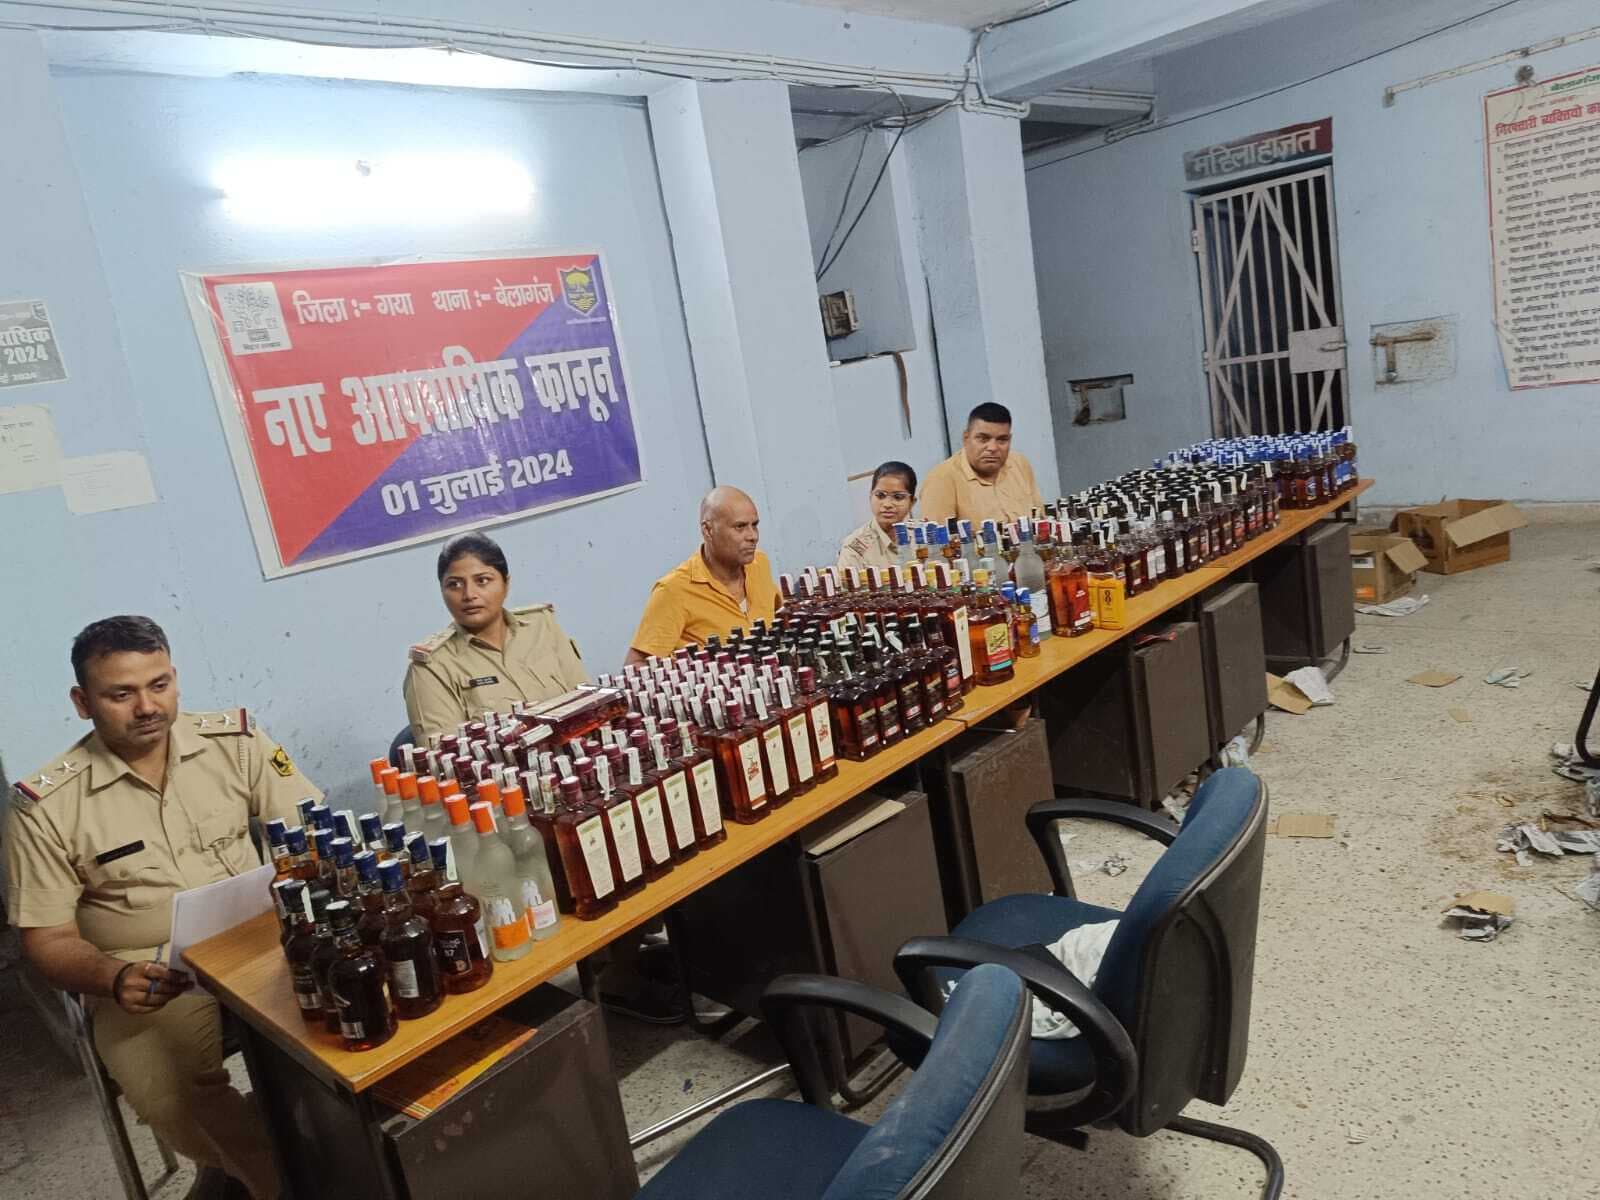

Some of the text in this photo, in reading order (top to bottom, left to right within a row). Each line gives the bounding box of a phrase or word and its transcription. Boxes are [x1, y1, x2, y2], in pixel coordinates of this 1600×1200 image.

[292, 290, 348, 324] जिला
[374, 293, 415, 316] गया
[432, 288, 472, 312] थाना
[494, 276, 555, 308] बेलागंज
[3, 344, 48, 365] 2024
[254, 345, 618, 456] नए आपराधिक कानून
[381, 449, 573, 516] 01 जुलाई 2024
